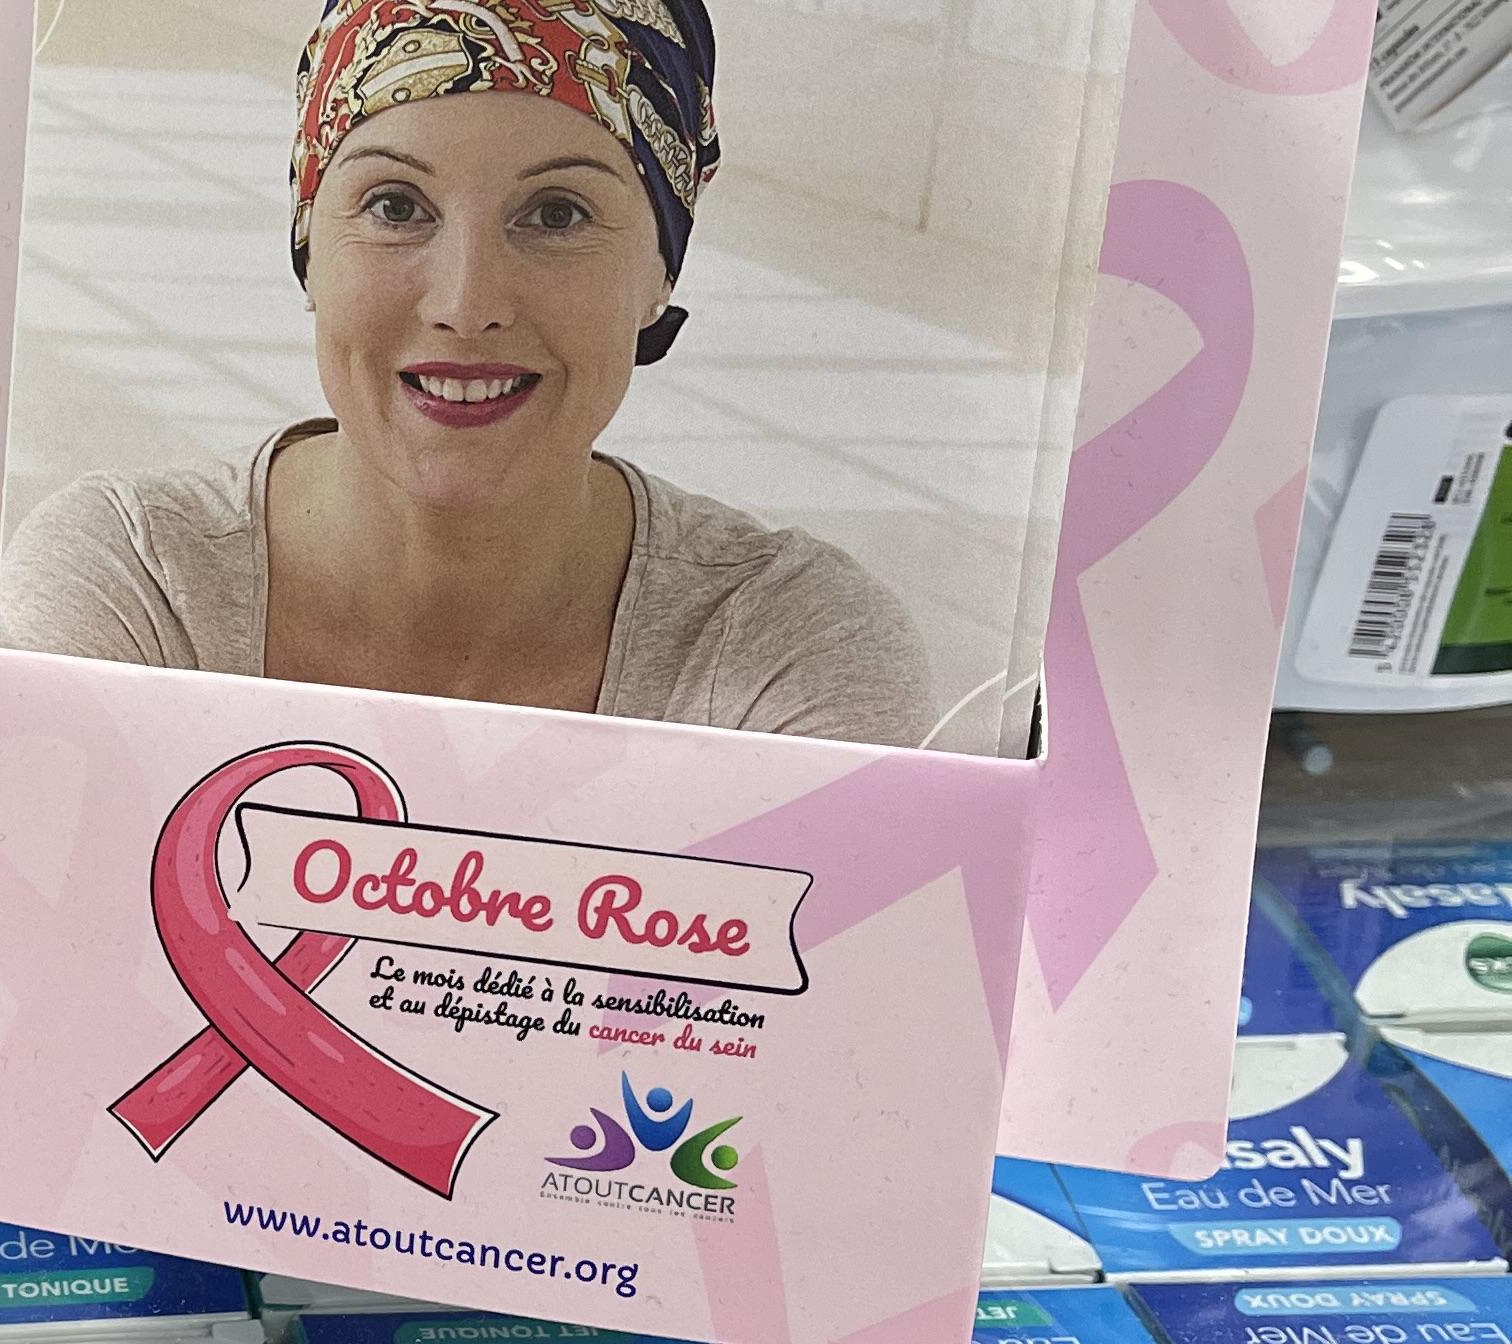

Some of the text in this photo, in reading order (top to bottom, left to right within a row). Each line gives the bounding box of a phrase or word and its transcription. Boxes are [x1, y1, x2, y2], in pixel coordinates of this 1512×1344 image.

[292, 838, 751, 957] Octobre Rose
[370, 955, 766, 1029] Le mois dédié à la sensibilisation
[369, 986, 757, 1059] et au dépistage du cancer du sein
[541, 1172, 736, 1215] ATOUTCANCER
[1142, 1178, 1393, 1212] Eau de Mer
[223, 1200, 640, 1298] www.atoutcancer.org
[1194, 1225, 1389, 1249] SPRAY DOUX
[1, 1277, 129, 1298] TONIQUE
